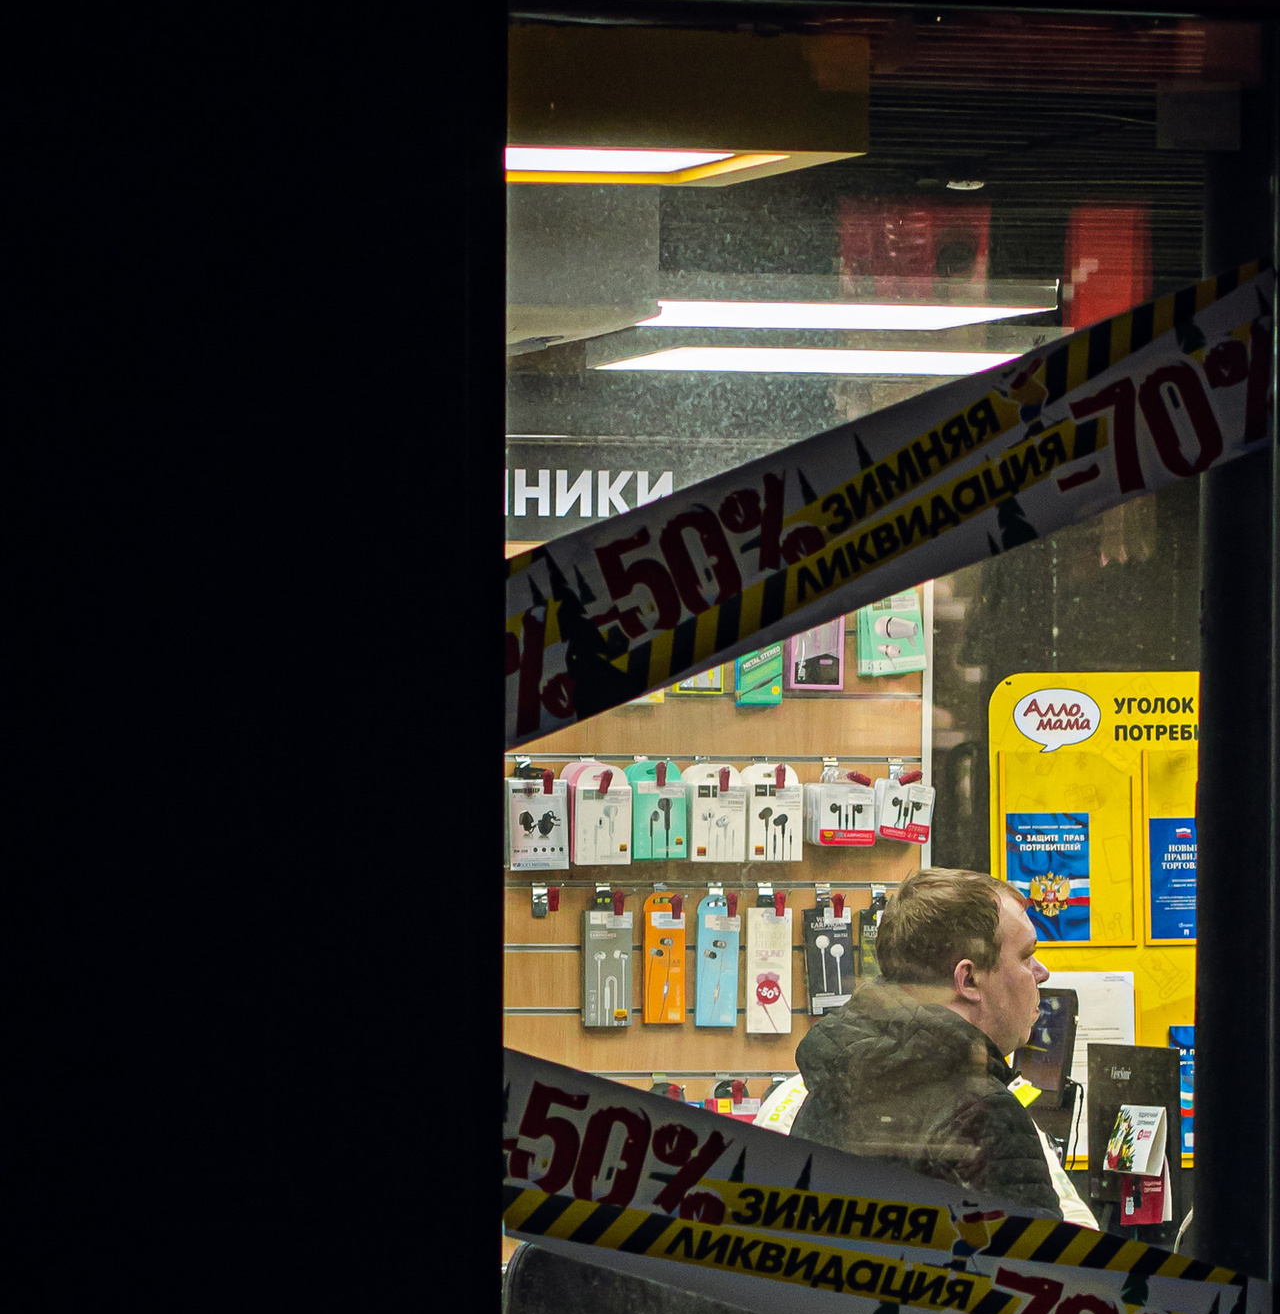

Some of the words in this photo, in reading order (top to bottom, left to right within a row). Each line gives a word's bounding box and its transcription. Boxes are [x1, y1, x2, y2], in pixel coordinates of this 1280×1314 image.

[821, 396, 1001, 535] ЗИМНЯЯ
[504, 469, 674, 518] НИКИ
[591, 469, 827, 639] -50%
[1036, 717, 1092, 731] мама
[1113, 697, 1195, 714] УГОЛОК
[1015, 834, 1023, 842] О
[1026, 834, 1059, 842] ЗАЩИТЕ
[1020, 842, 1081, 851] ПОТРЕБИТЕЛЕЙ
[502, 1080, 733, 1225] -50%
[731, 1188, 939, 1245] ЗИМНЯЯ
